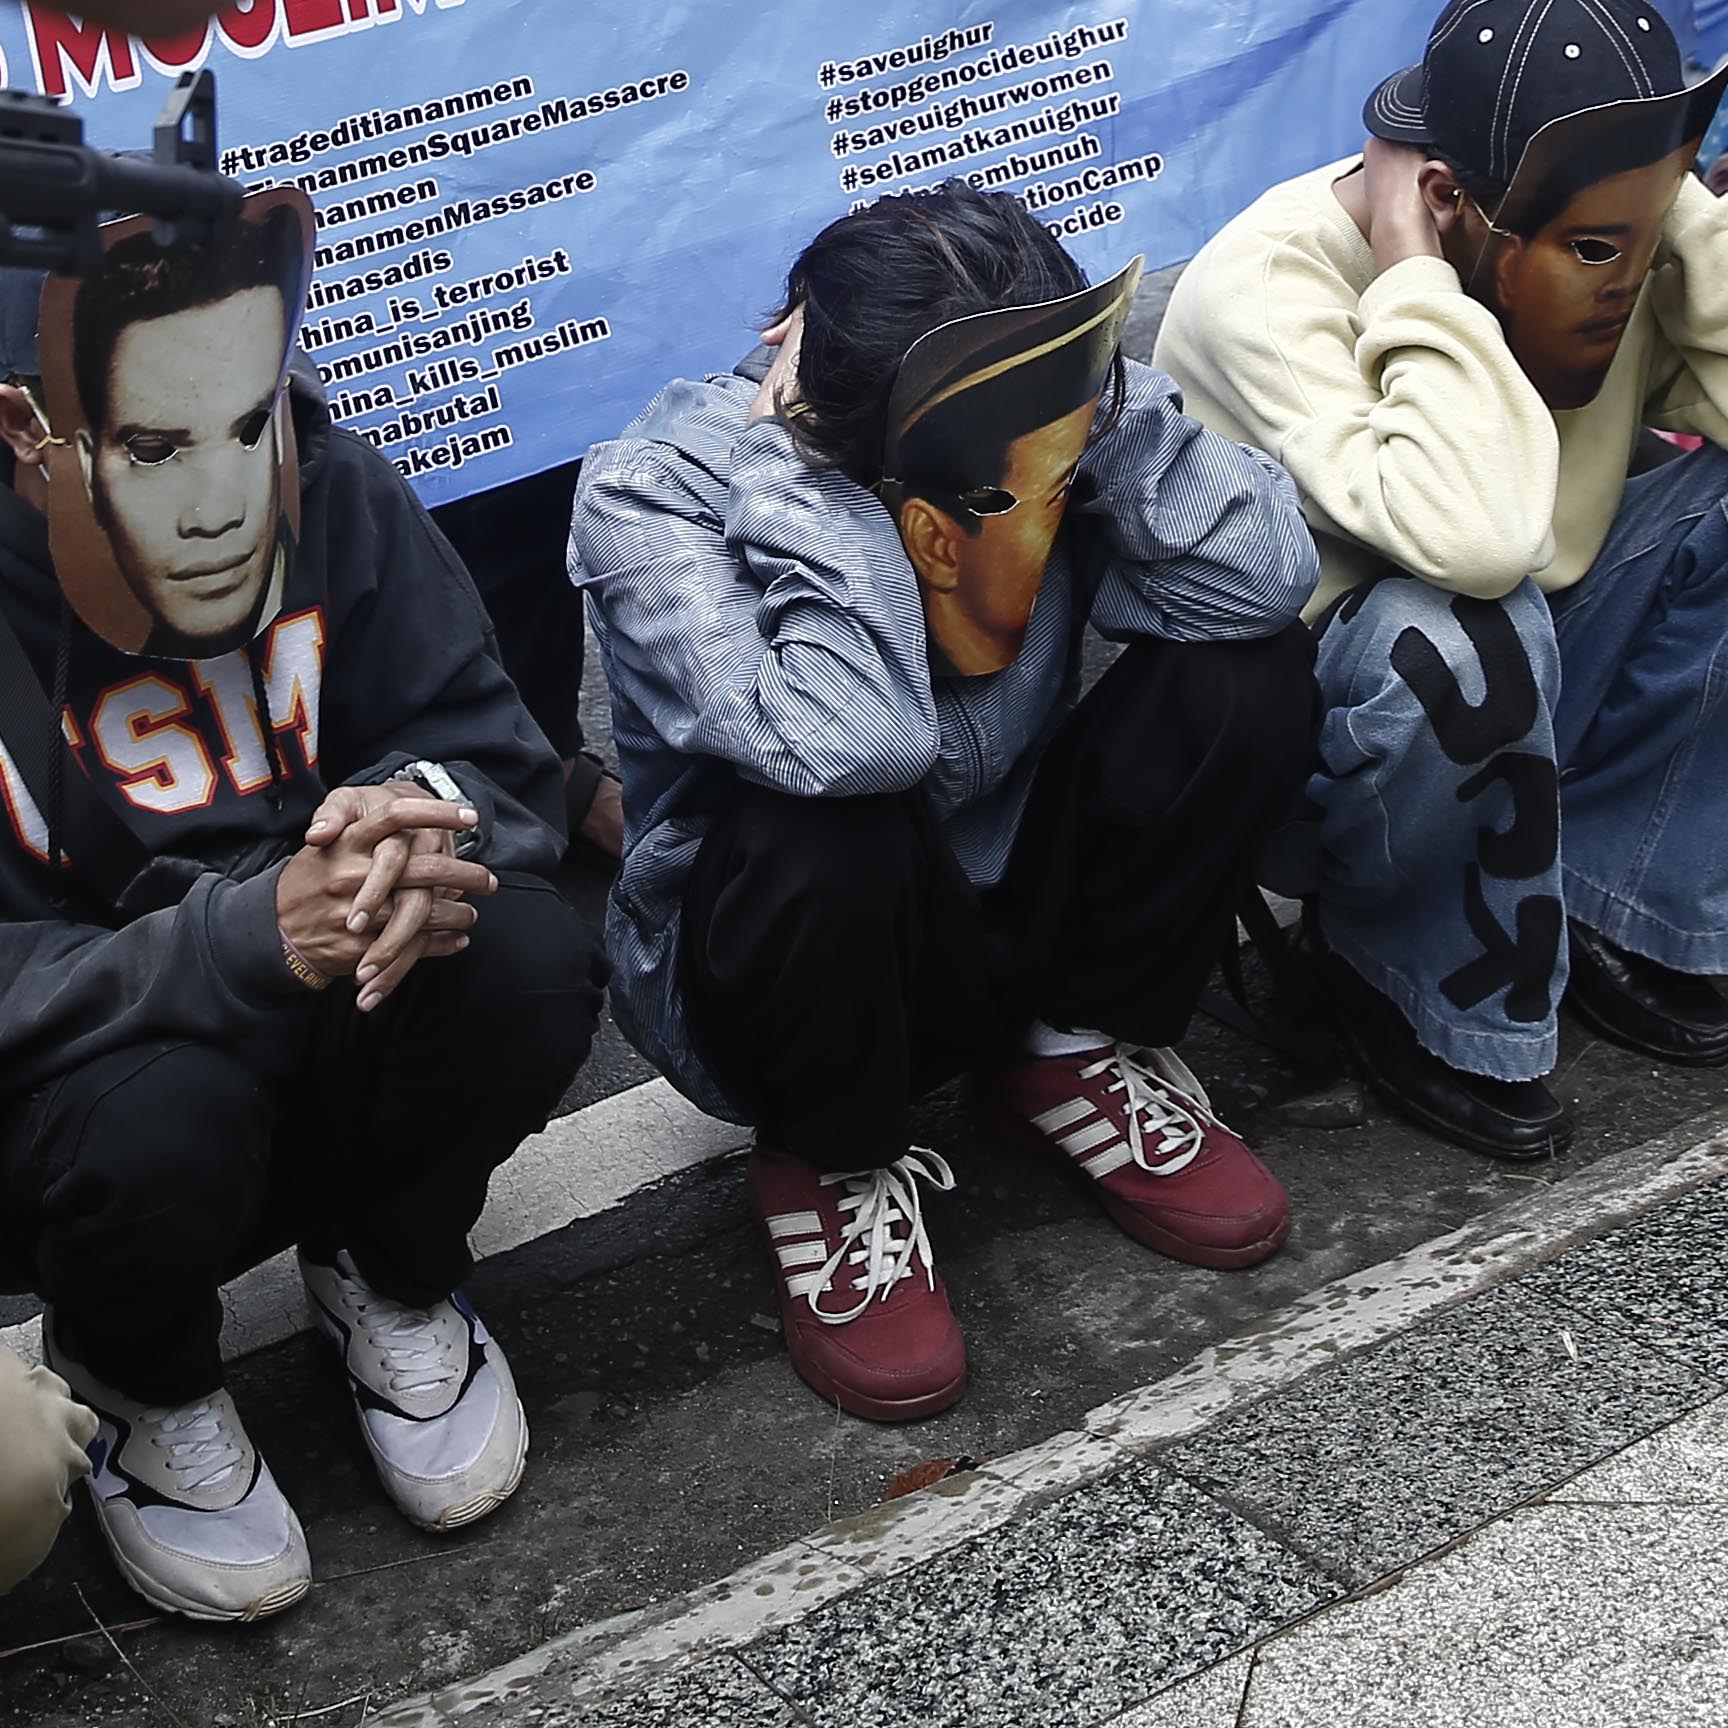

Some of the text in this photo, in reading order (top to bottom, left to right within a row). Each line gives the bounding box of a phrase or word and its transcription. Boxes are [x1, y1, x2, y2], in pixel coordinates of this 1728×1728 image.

[819, 22, 993, 87] #saveuighur
[826, 18, 1128, 121] #stopgenocideuighur
[220, 76, 532, 175] #trageditiananmen
[247, 71, 689, 193] nanmenSquareMassacre
[833, 62, 1111, 156] #saveuighurwomen
[841, 94, 1121, 191] #selamatkanuighur
[314, 171, 595, 268] nanmenMassacre
[299, 251, 569, 351] hina_is_terrorist
[307, 251, 451, 310] inasadis
[319, 301, 532, 386] omunisanjing
[328, 317, 610, 420] hina_kills_muslim
[357, 389, 500, 448] nabrutal
[398, 425, 511, 478] akejam
